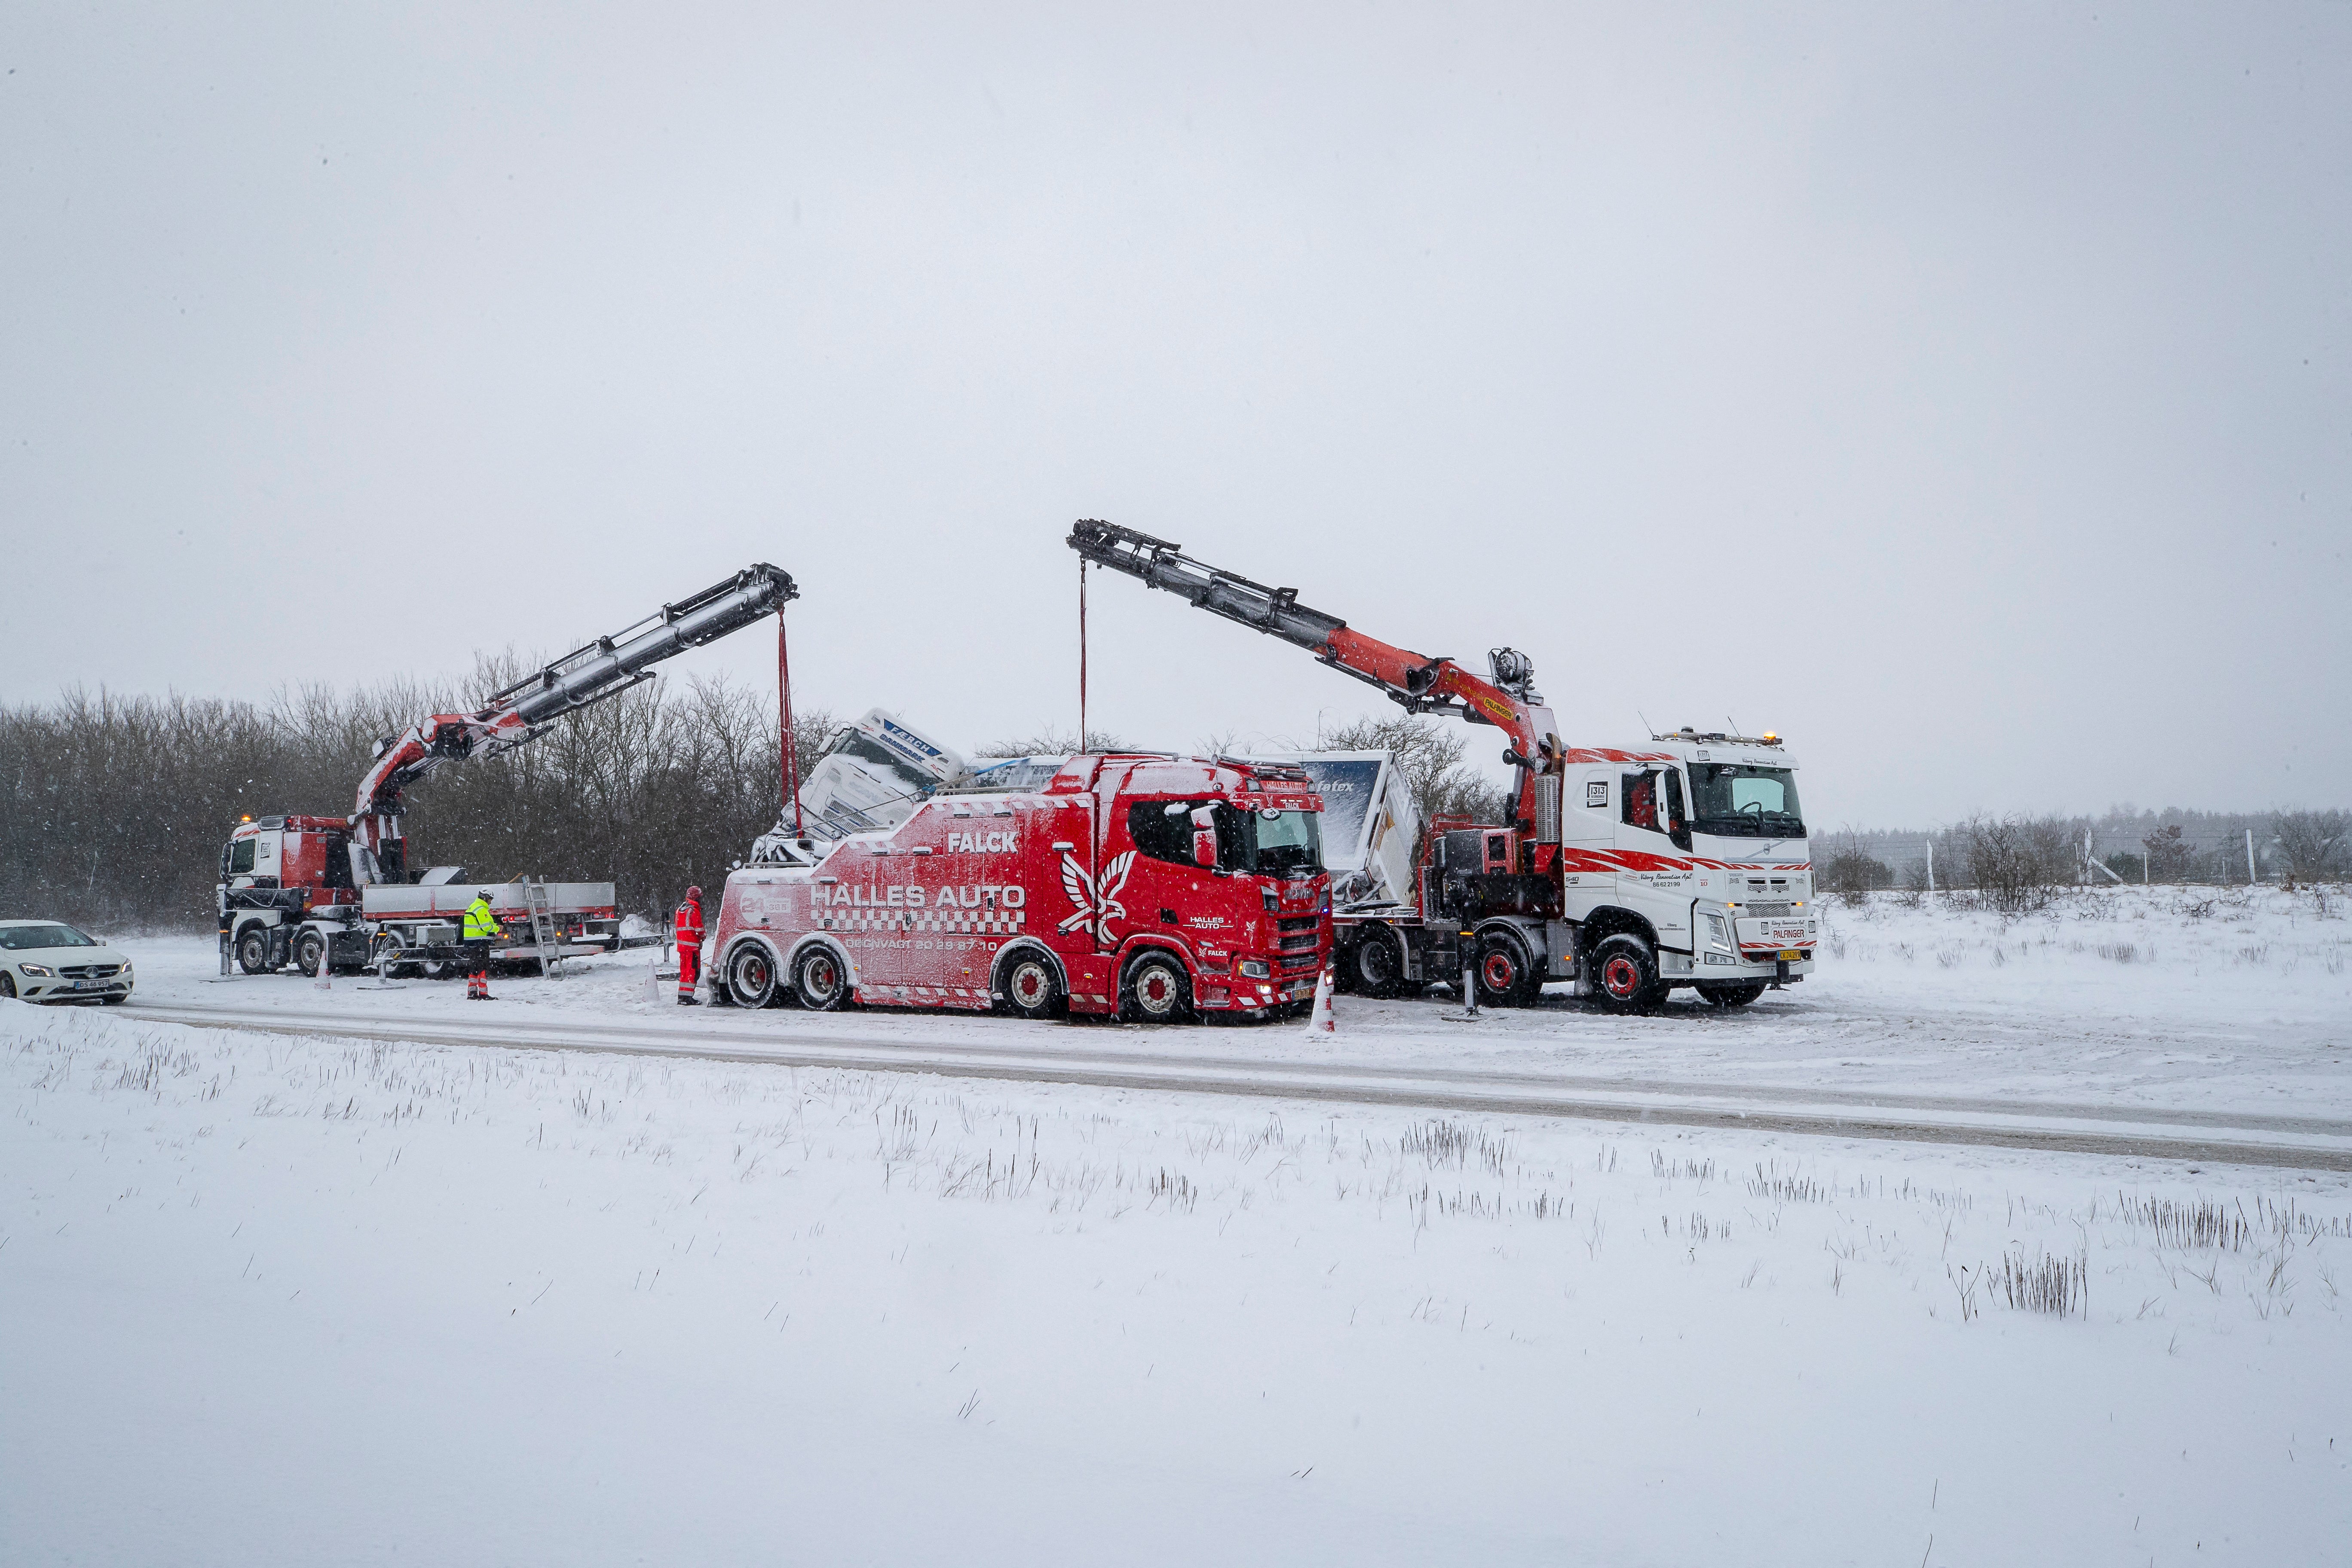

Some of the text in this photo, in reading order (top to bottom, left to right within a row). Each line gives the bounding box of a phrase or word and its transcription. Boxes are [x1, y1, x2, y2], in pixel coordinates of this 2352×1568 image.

[1485, 698, 1512, 719] PALFINGER
[879, 733, 925, 763] DANMARK
[890, 726, 930, 752] FÆRCH
[1317, 779, 1354, 792] føtex
[948, 832, 1018, 854] FALCK
[1641, 874, 1654, 882] Viborg
[1681, 873, 1693, 881] ApS
[811, 885, 1025, 908] HALLES AUTO
[1773, 929, 1804, 938] PALFINGER
[916, 940, 932, 949] 20
[937, 940, 953, 950] 29
[958, 941, 974, 950] 87
[981, 942, 997, 951] 10
